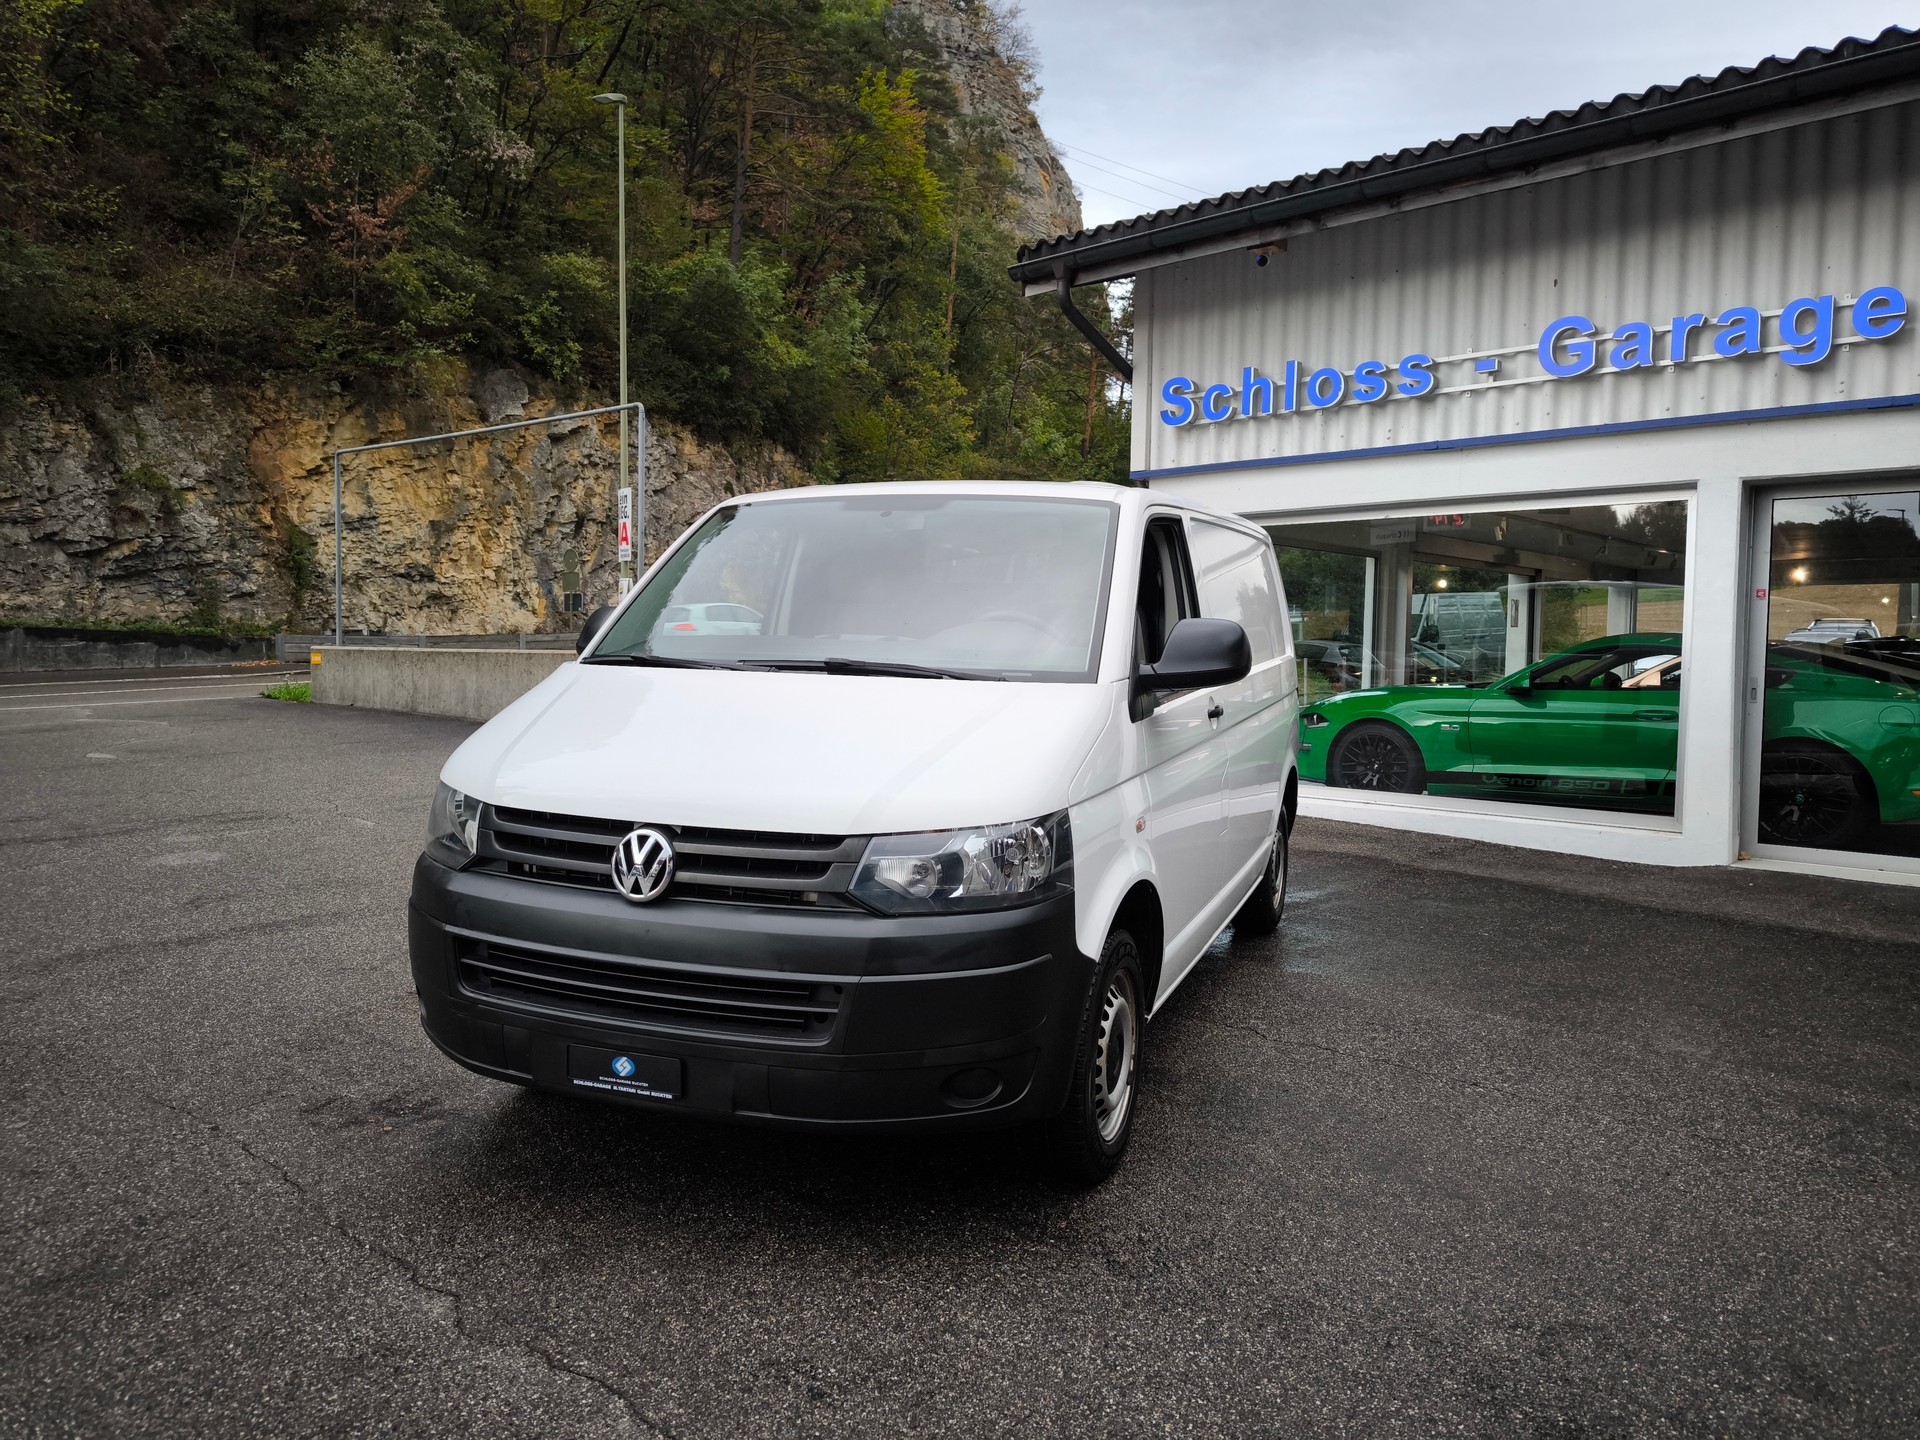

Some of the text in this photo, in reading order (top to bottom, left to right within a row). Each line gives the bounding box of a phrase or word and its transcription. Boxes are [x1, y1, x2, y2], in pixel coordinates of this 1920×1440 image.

[1160, 354, 1438, 427] Schloss
[1538, 285, 1907, 378] Garage
[1481, 774, 1610, 791] Venom 850
